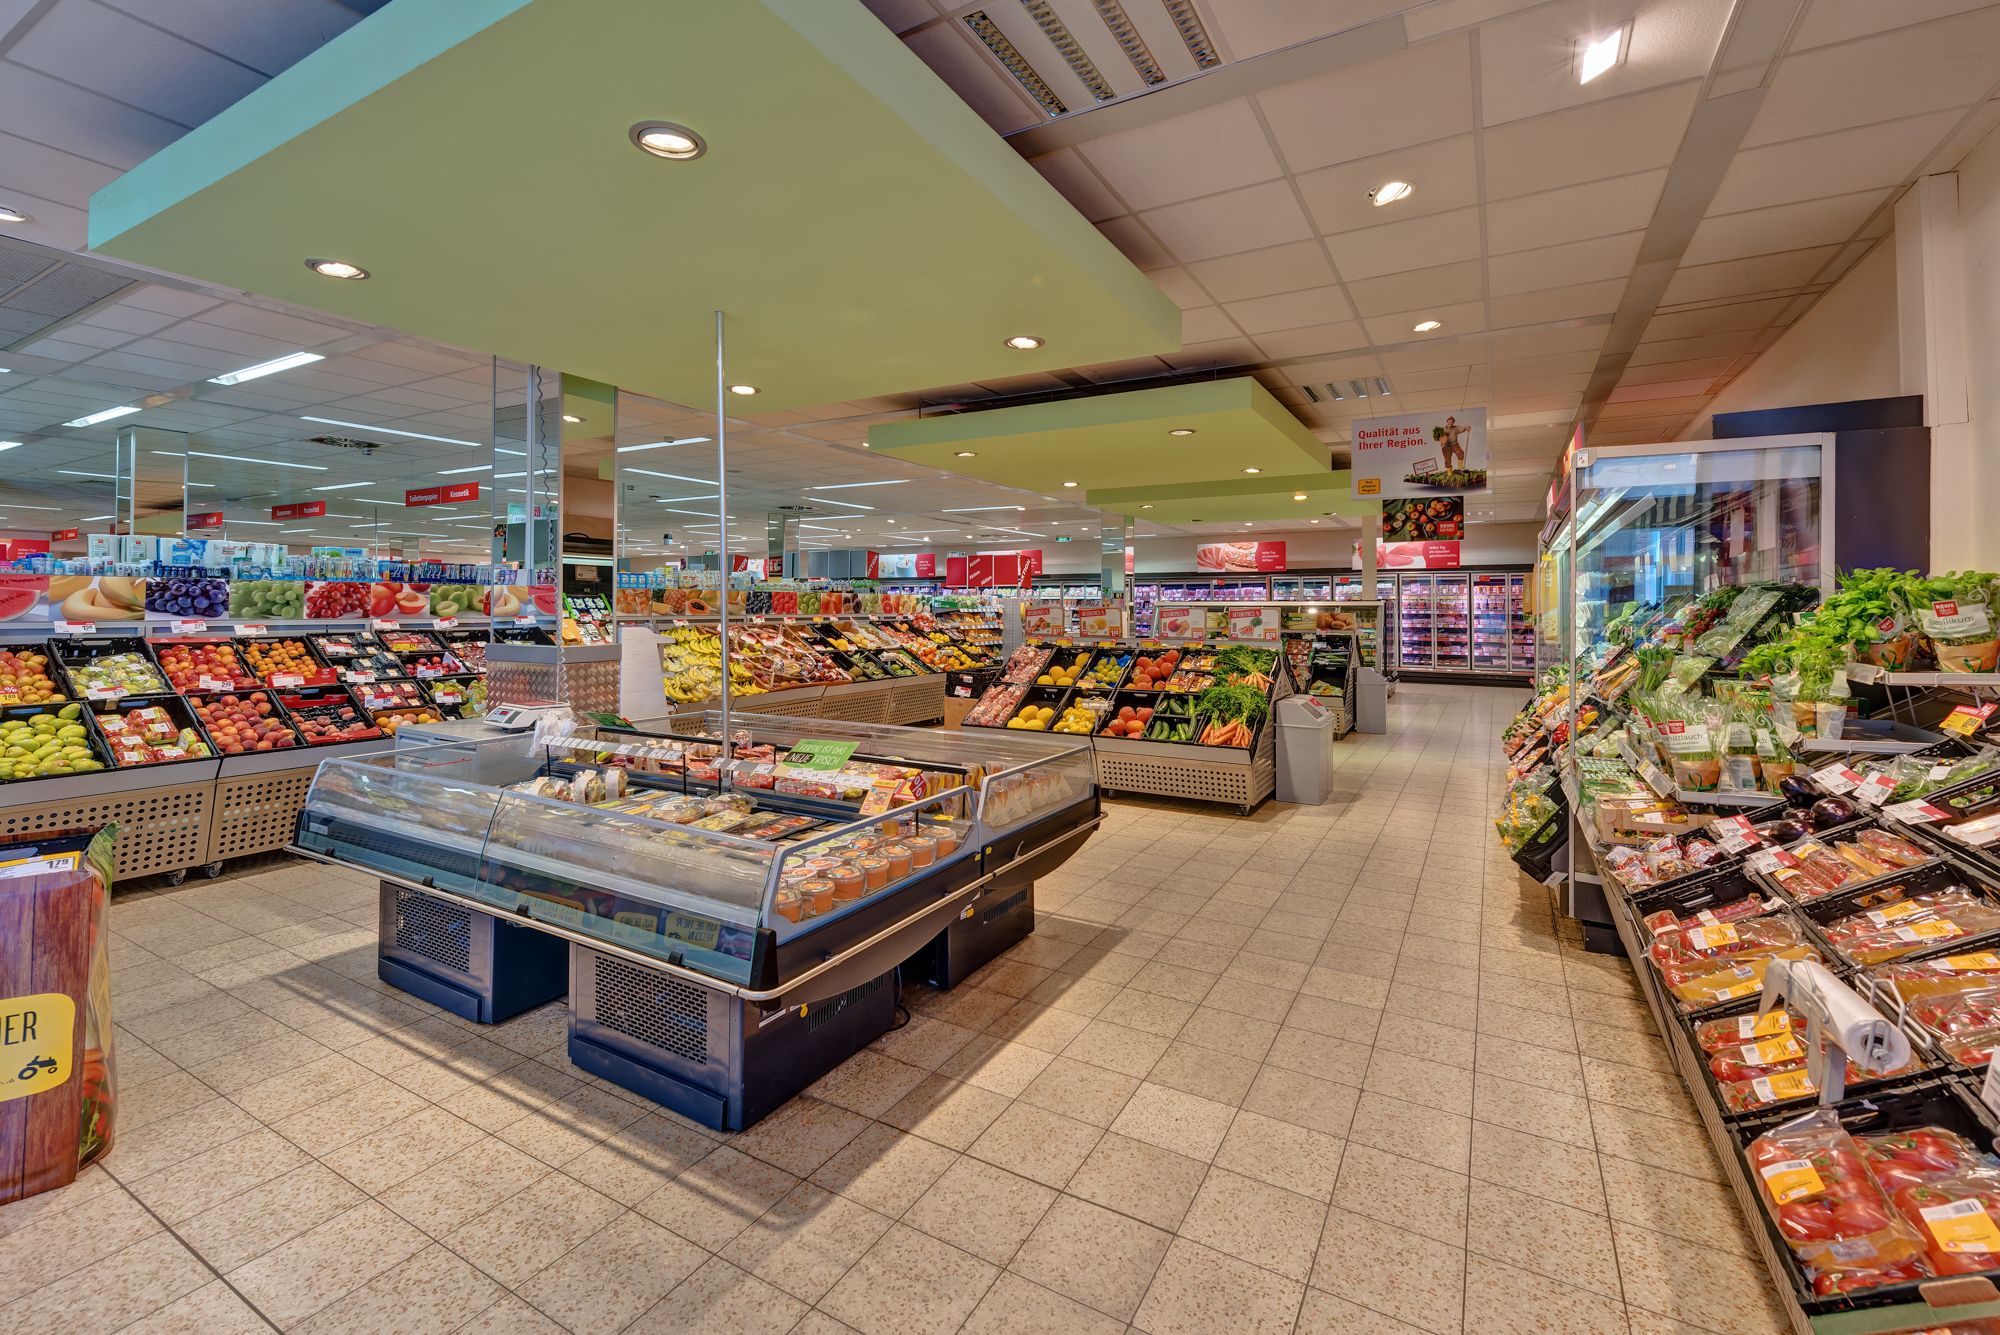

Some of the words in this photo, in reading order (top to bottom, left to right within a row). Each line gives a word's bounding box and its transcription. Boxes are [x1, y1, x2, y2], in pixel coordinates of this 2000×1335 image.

[1358, 427, 1399, 440] Qualität
[1403, 427, 1420, 435] aus
[1358, 441, 1383, 450] Ihrer
[1387, 438, 1427, 449] Region.
[409, 494, 438, 502] Toilettenpapier
[450, 489, 469, 498] Kosmetik
[969, 558, 981, 568] Aktion
[969, 570, 981, 580] Aktion
[980, 576, 993, 586] Aktion
[1928, 616, 1975, 626] Basilikum
[833, 746, 848, 755] DAS
[788, 753, 813, 763] NEUE
[0, 1011, 37, 1045] ER
